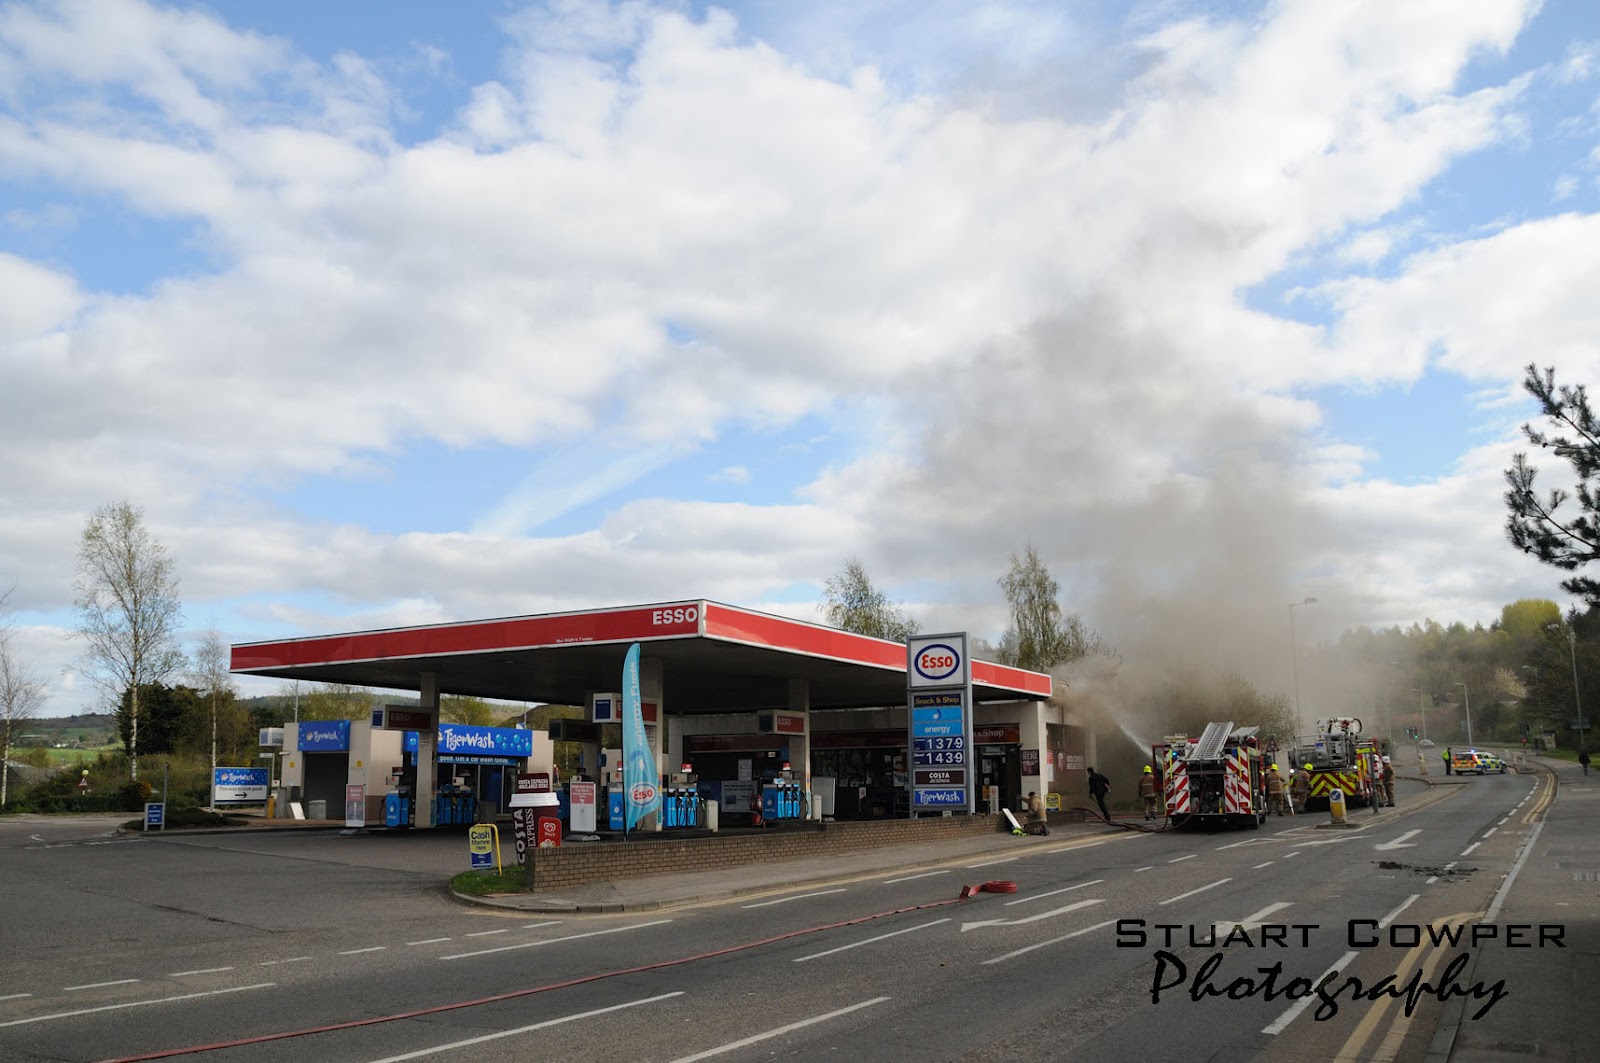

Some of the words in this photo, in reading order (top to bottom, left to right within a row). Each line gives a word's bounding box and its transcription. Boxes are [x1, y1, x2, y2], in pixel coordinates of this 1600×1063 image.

[652, 607, 698, 625] ESSO
[921, 654, 953, 669] Esso
[942, 696, 960, 704] Shop
[924, 726, 951, 735] energy
[444, 728, 495, 751] TigerWash
[633, 789, 653, 800] Esso
[918, 790, 960, 805] TigerWash
[471, 830, 490, 840] Cash
[513, 808, 527, 865] COSTA
[526, 808, 537, 847] EXPRESS
